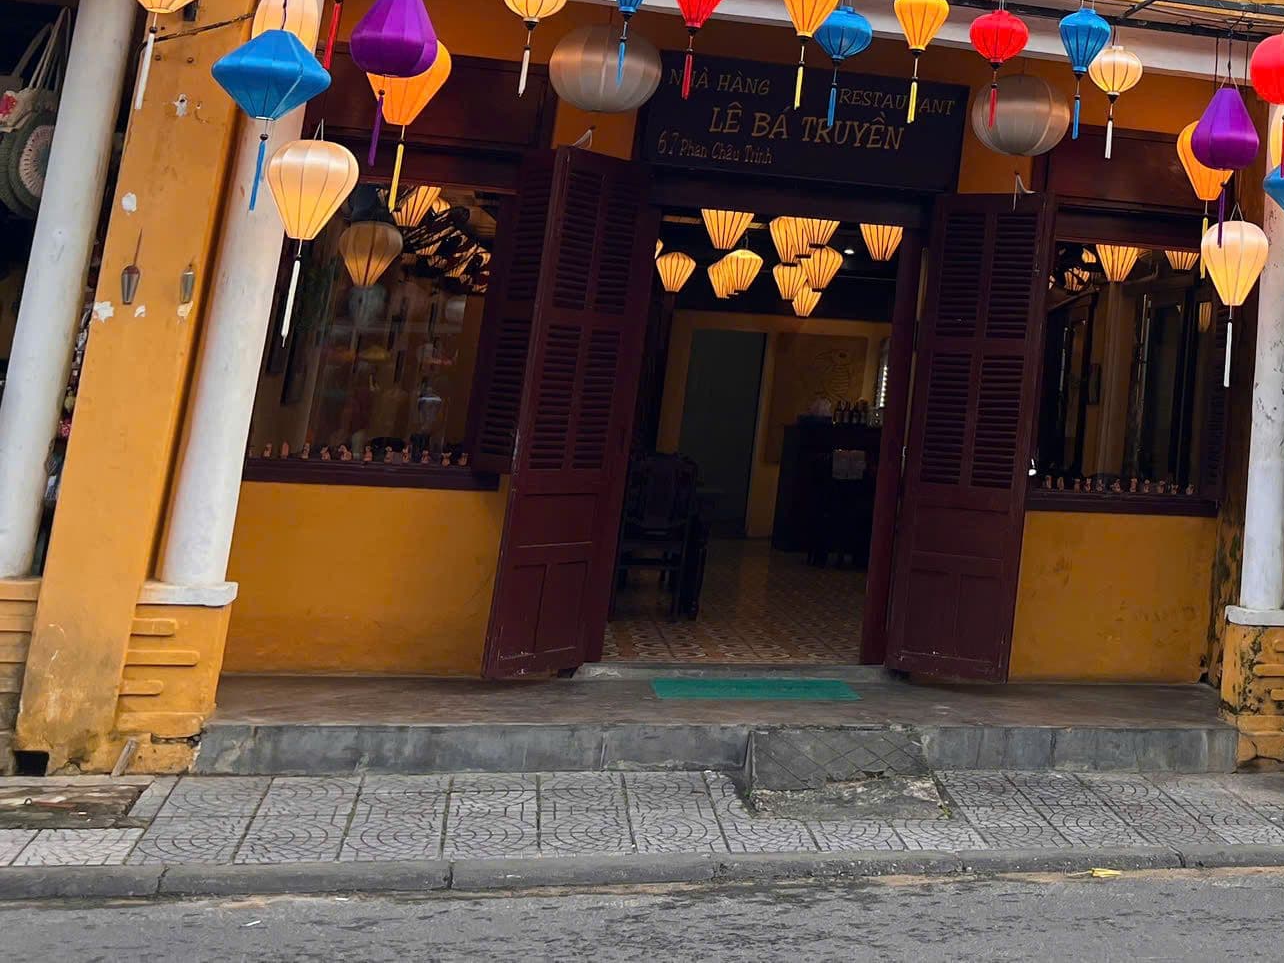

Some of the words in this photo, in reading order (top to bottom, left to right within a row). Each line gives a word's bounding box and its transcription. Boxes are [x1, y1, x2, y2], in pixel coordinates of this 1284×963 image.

[717, 69, 771, 96] HÀNG
[838, 87, 956, 116] RESTAUANT
[709, 100, 743, 134] LÊ
[751, 105, 792, 139] BÁ
[800, 111, 906, 150] TRUYỀN
